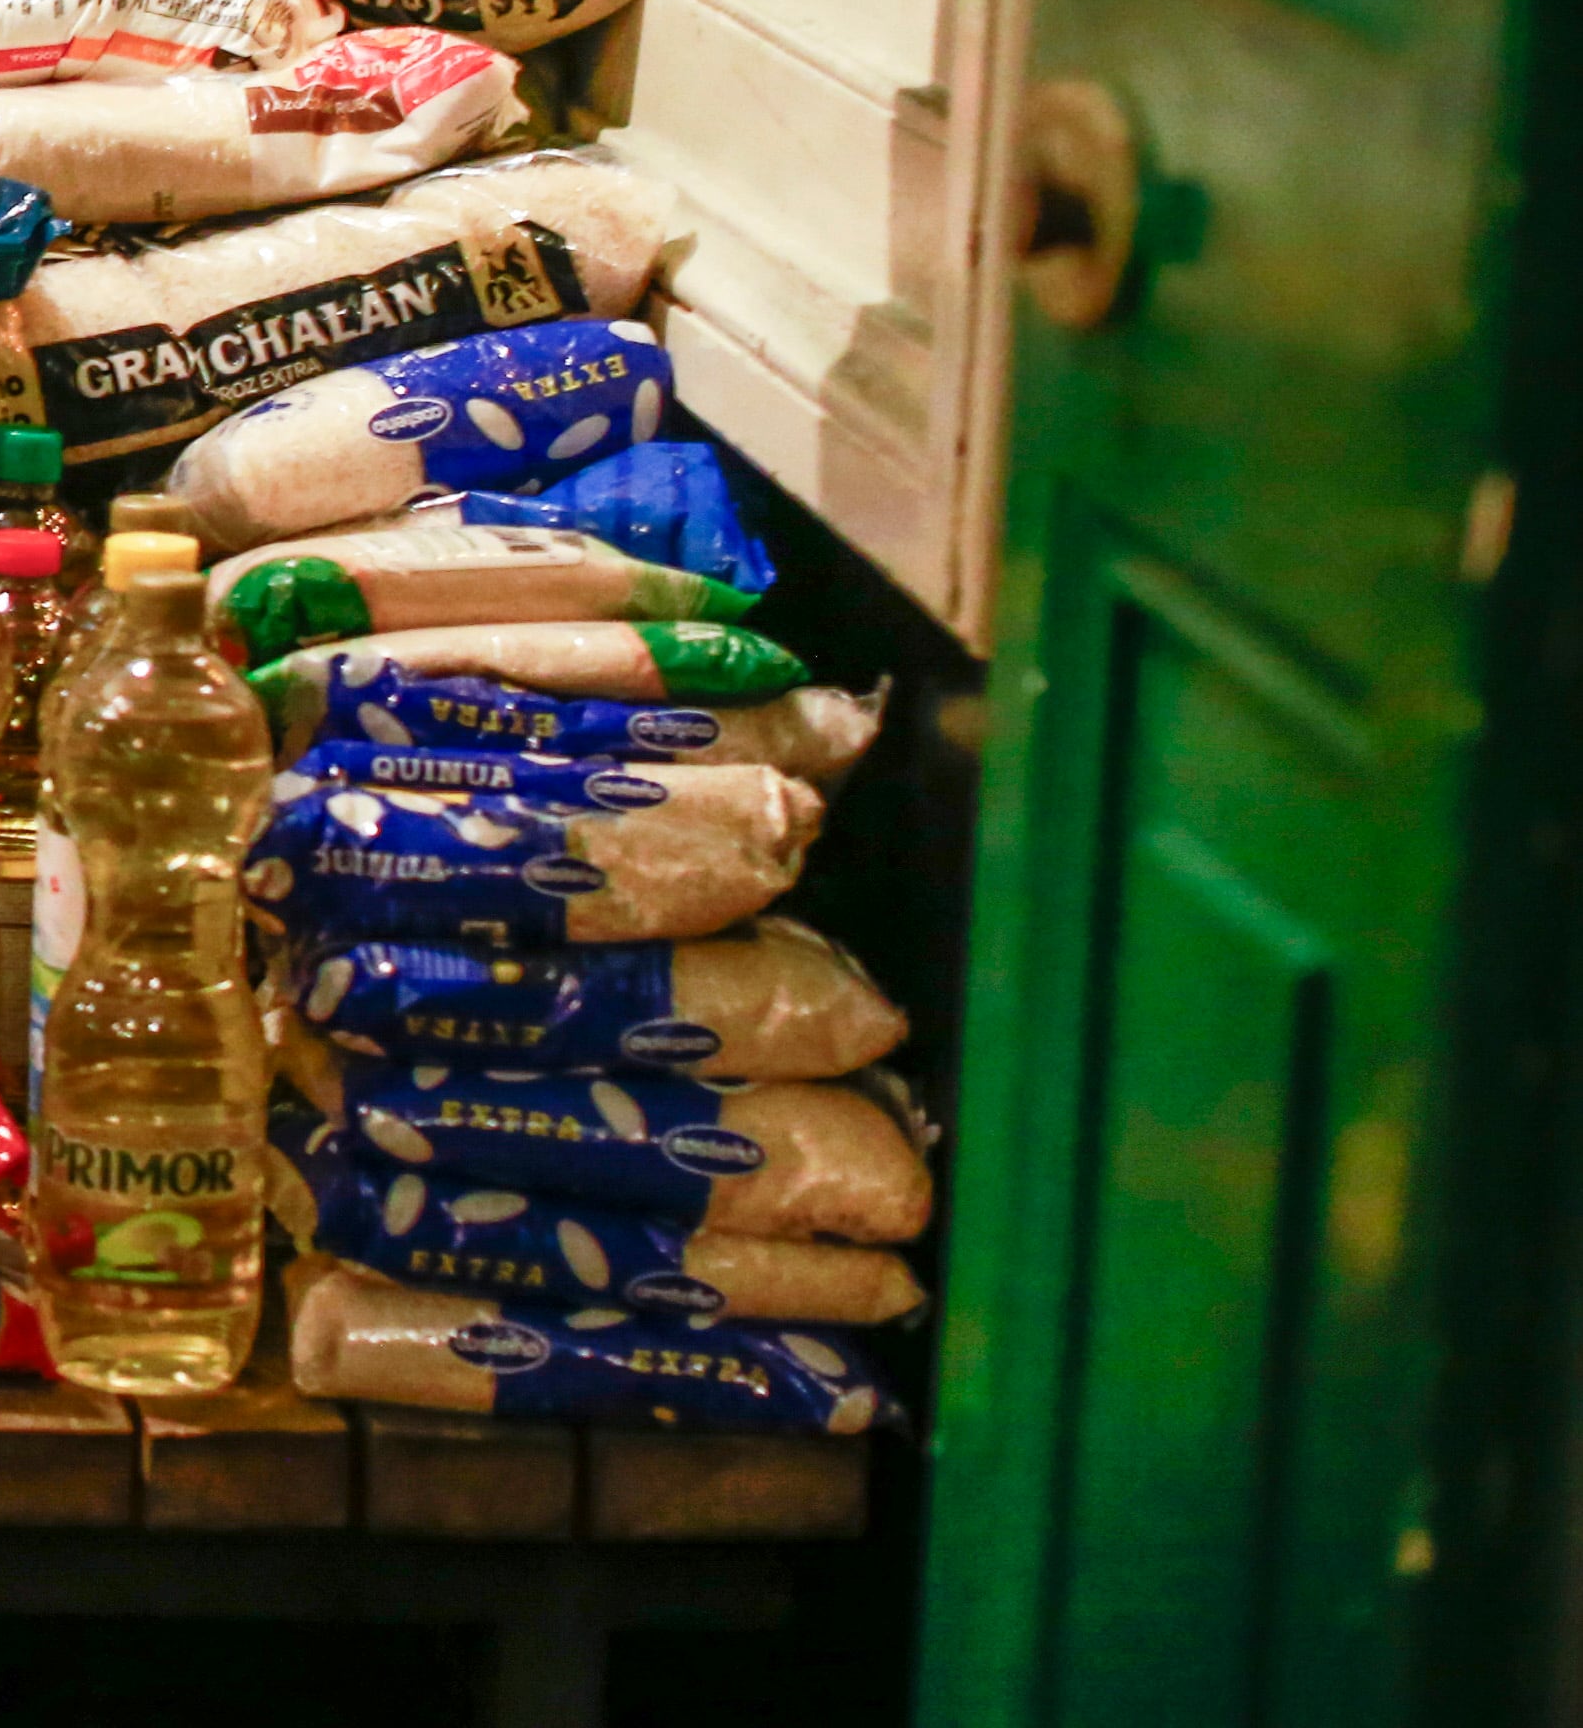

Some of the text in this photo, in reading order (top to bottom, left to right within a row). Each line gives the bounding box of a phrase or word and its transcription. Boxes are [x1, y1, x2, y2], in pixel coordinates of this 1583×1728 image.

[512, 353, 630, 401] EXTRA
[370, 755, 514, 789] QUINUA
[44, 1124, 234, 1198] PRIMOR
